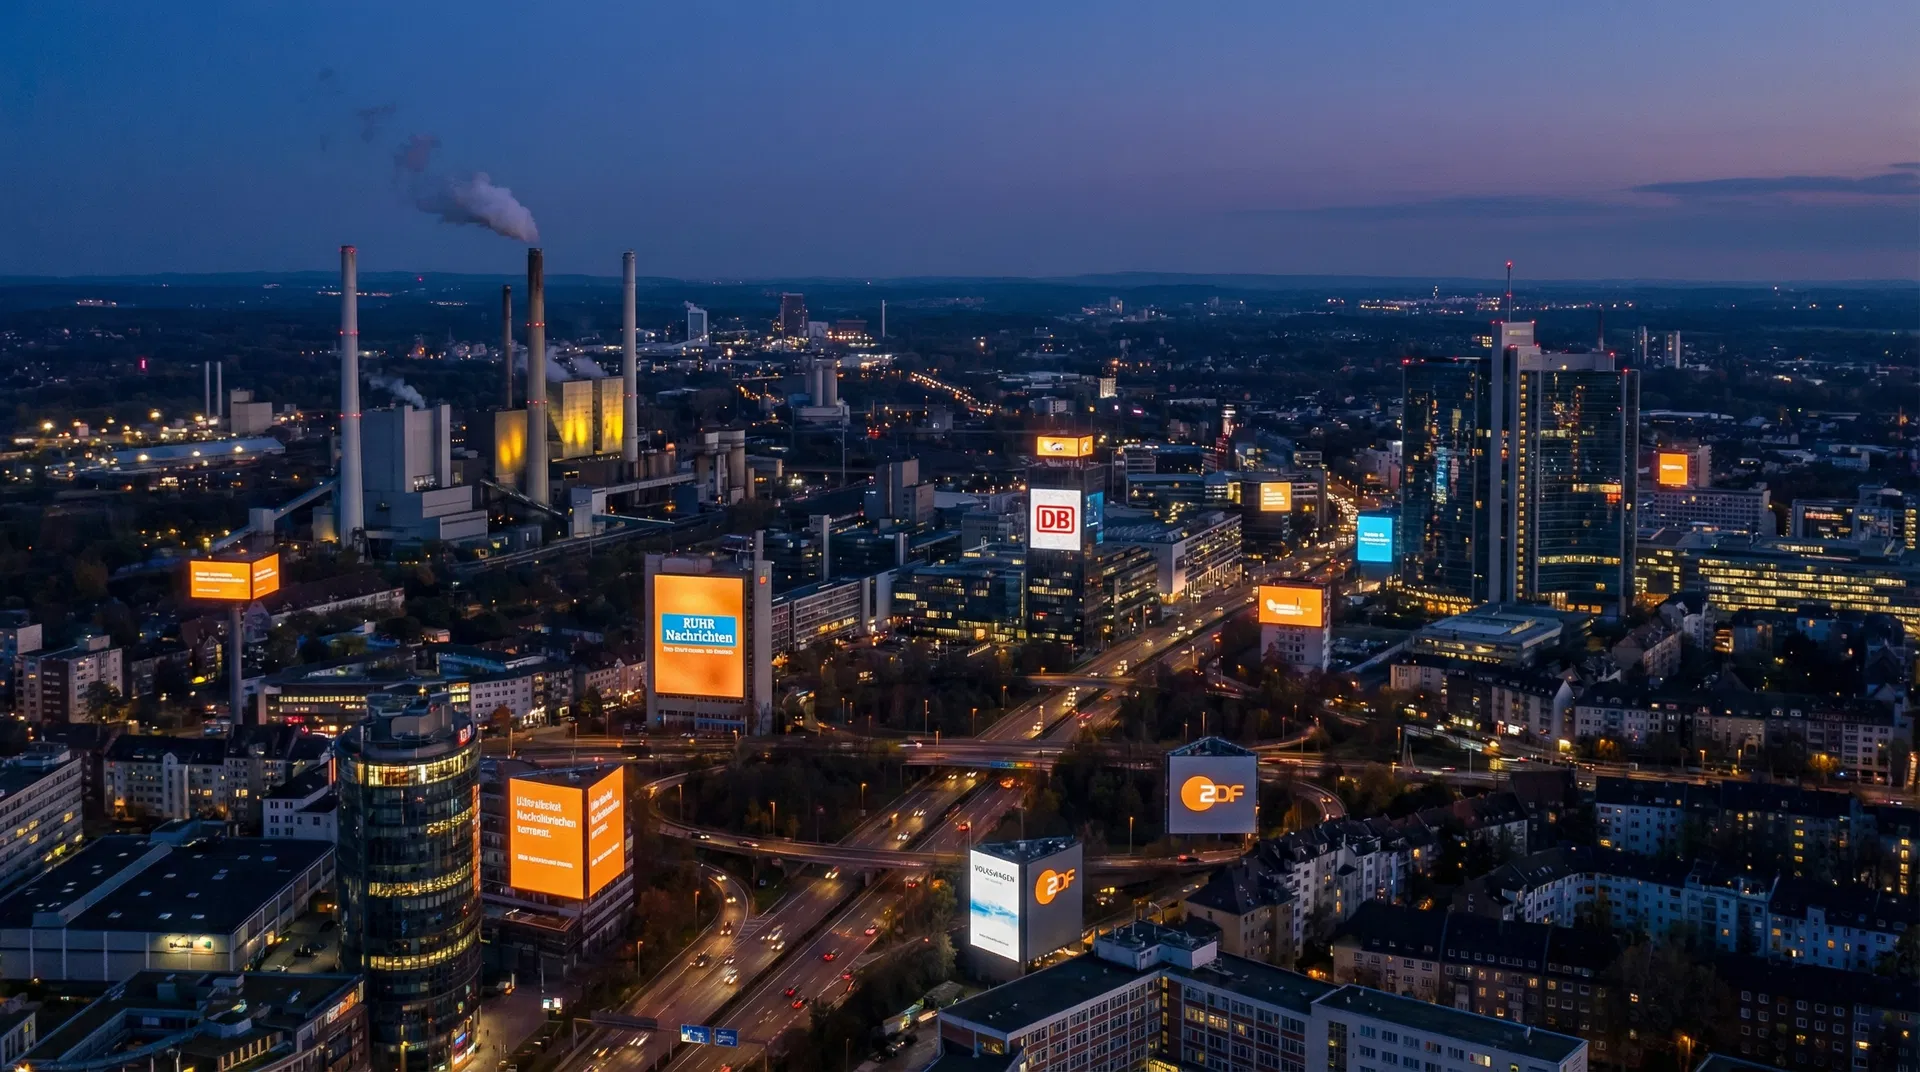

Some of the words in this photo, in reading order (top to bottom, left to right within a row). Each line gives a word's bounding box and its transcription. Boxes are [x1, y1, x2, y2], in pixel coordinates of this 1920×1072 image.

[1041, 509, 1070, 529] DB
[683, 617, 715, 630] RUHR
[665, 629, 733, 643] Nachrichten
[974, 864, 1015, 883] VOLKSWAGEN
